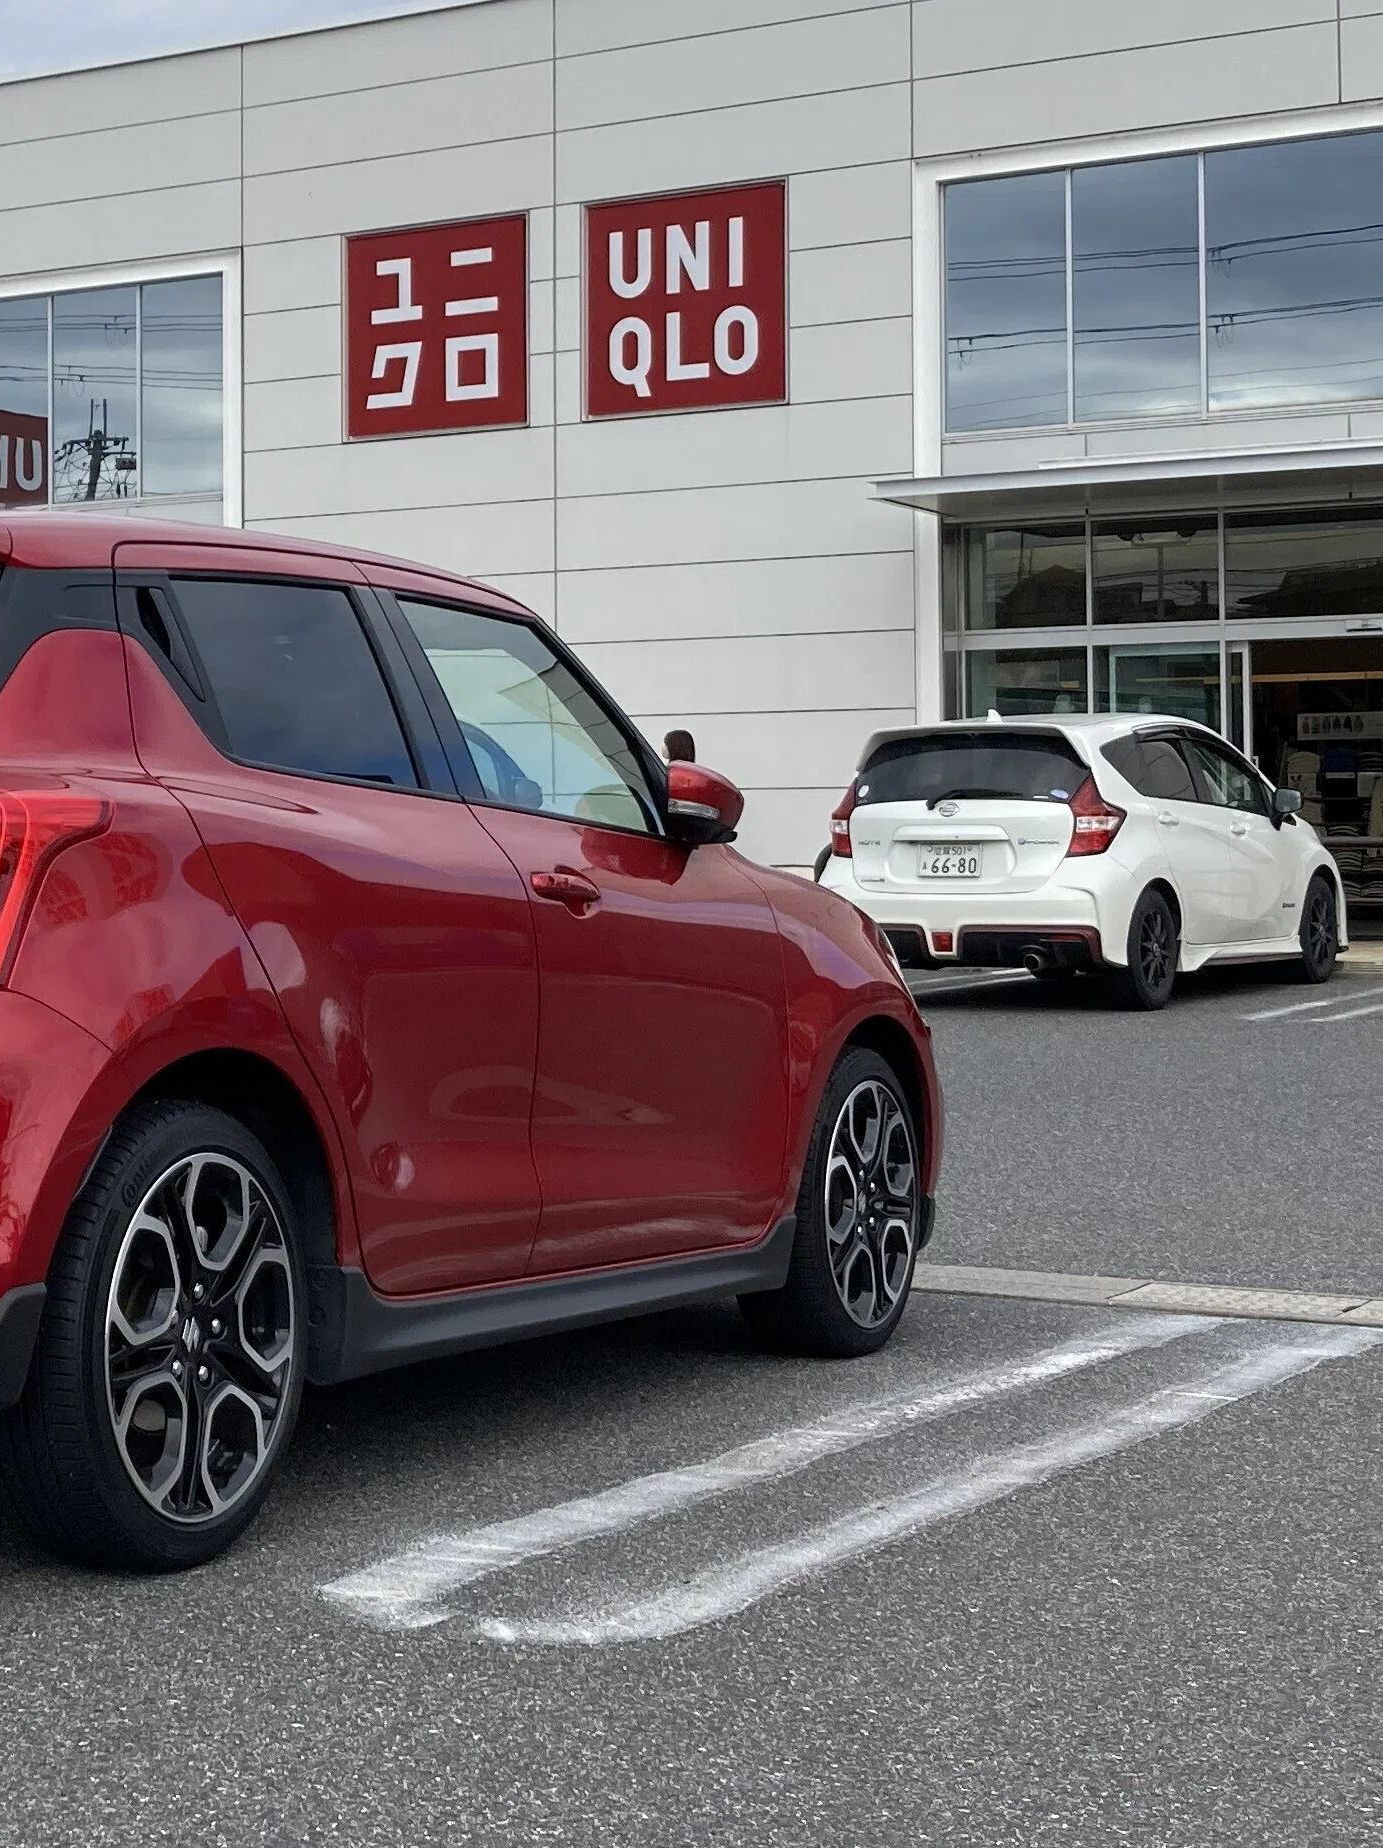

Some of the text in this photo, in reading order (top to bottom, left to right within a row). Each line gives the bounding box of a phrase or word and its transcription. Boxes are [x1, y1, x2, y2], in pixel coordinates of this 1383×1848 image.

[371, 247, 498, 325] ユニ
[609, 216, 743, 299] UNI
[366, 333, 499, 410] クロ
[609, 305, 759, 398] QLO
[931, 857, 977, 873] 66-80
